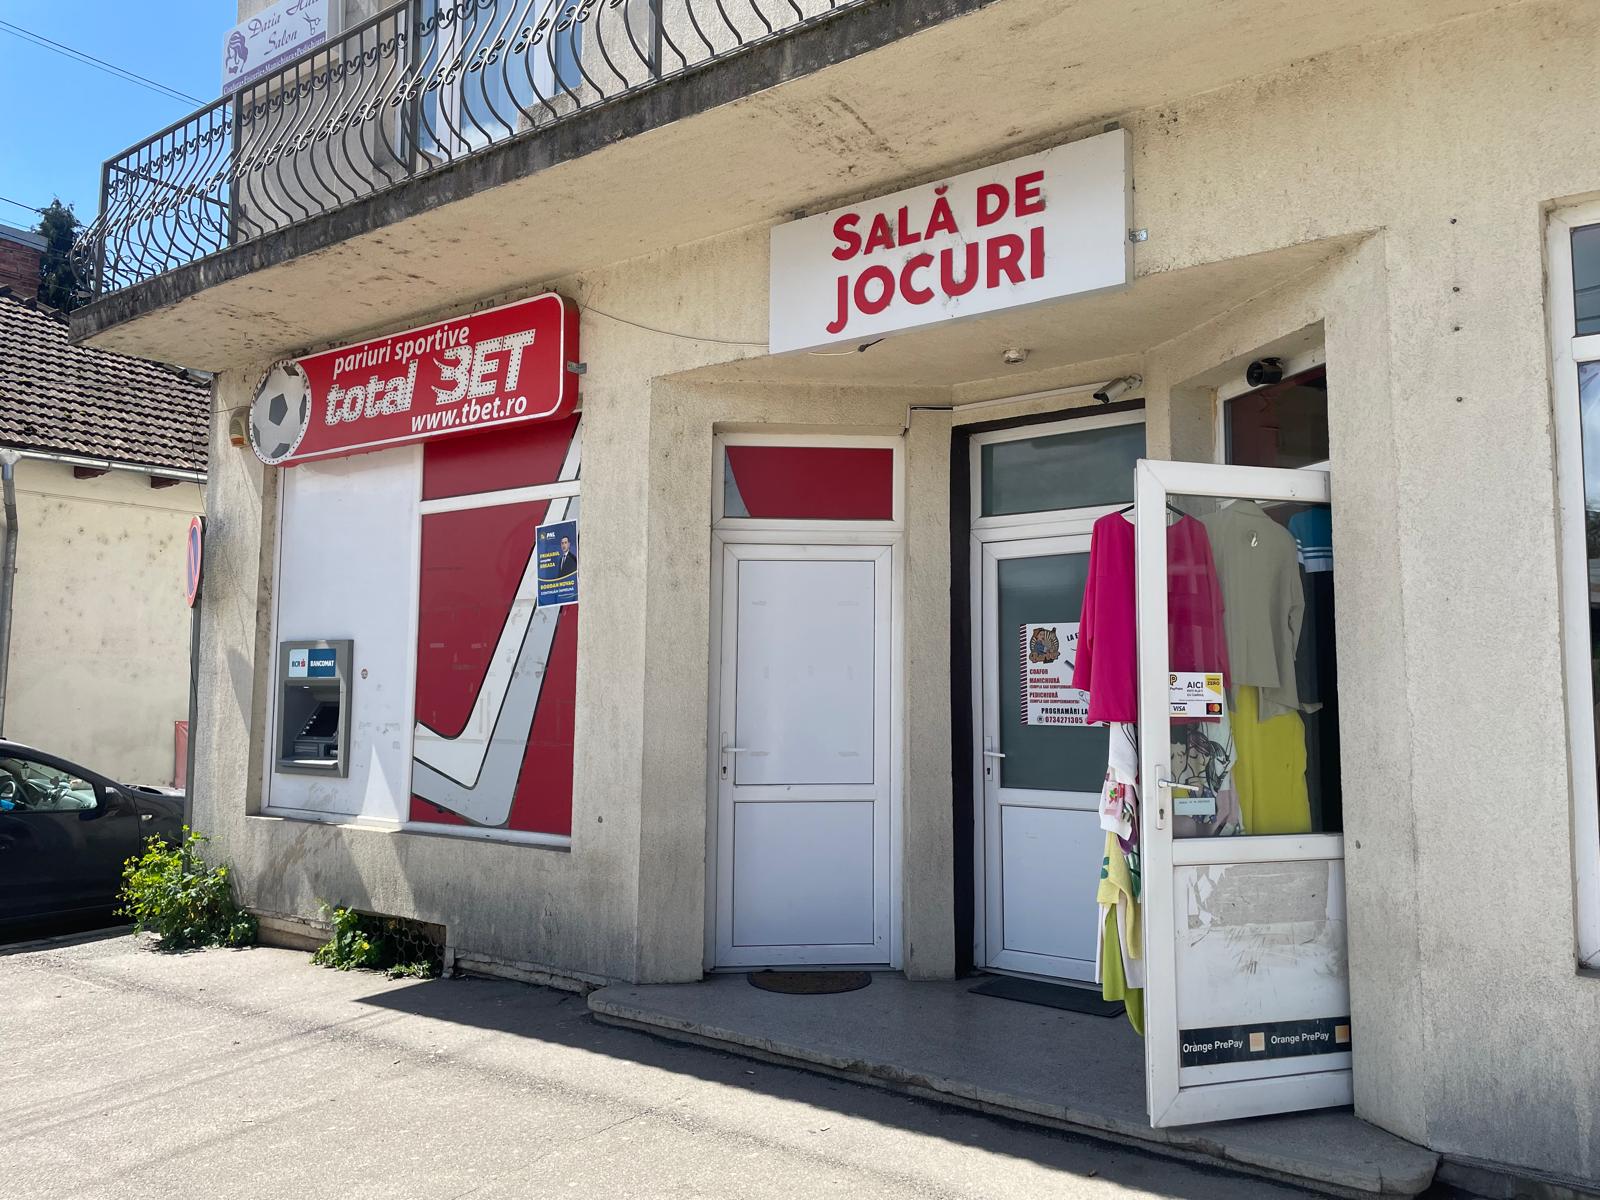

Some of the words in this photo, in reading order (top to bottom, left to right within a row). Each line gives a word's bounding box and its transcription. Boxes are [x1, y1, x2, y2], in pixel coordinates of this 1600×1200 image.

[264, 29, 297, 55] Salon
[832, 185, 959, 261] SALĂ
[977, 170, 1045, 227] DE
[826, 226, 1045, 334] JOCURI
[333, 340, 391, 380] pariuri
[395, 325, 470, 364] sportive
[325, 359, 418, 425] total
[431, 328, 536, 406] BET
[411, 396, 527, 432] www.tbet.ro
[1041, 707, 1080, 715] PROGRAMĂRI
[1183, 1042, 1212, 1053] Orange
[1214, 1040, 1243, 1049] PrePay
[1271, 1034, 1300, 1044] Orange
[1302, 1032, 1330, 1041] PrePay
